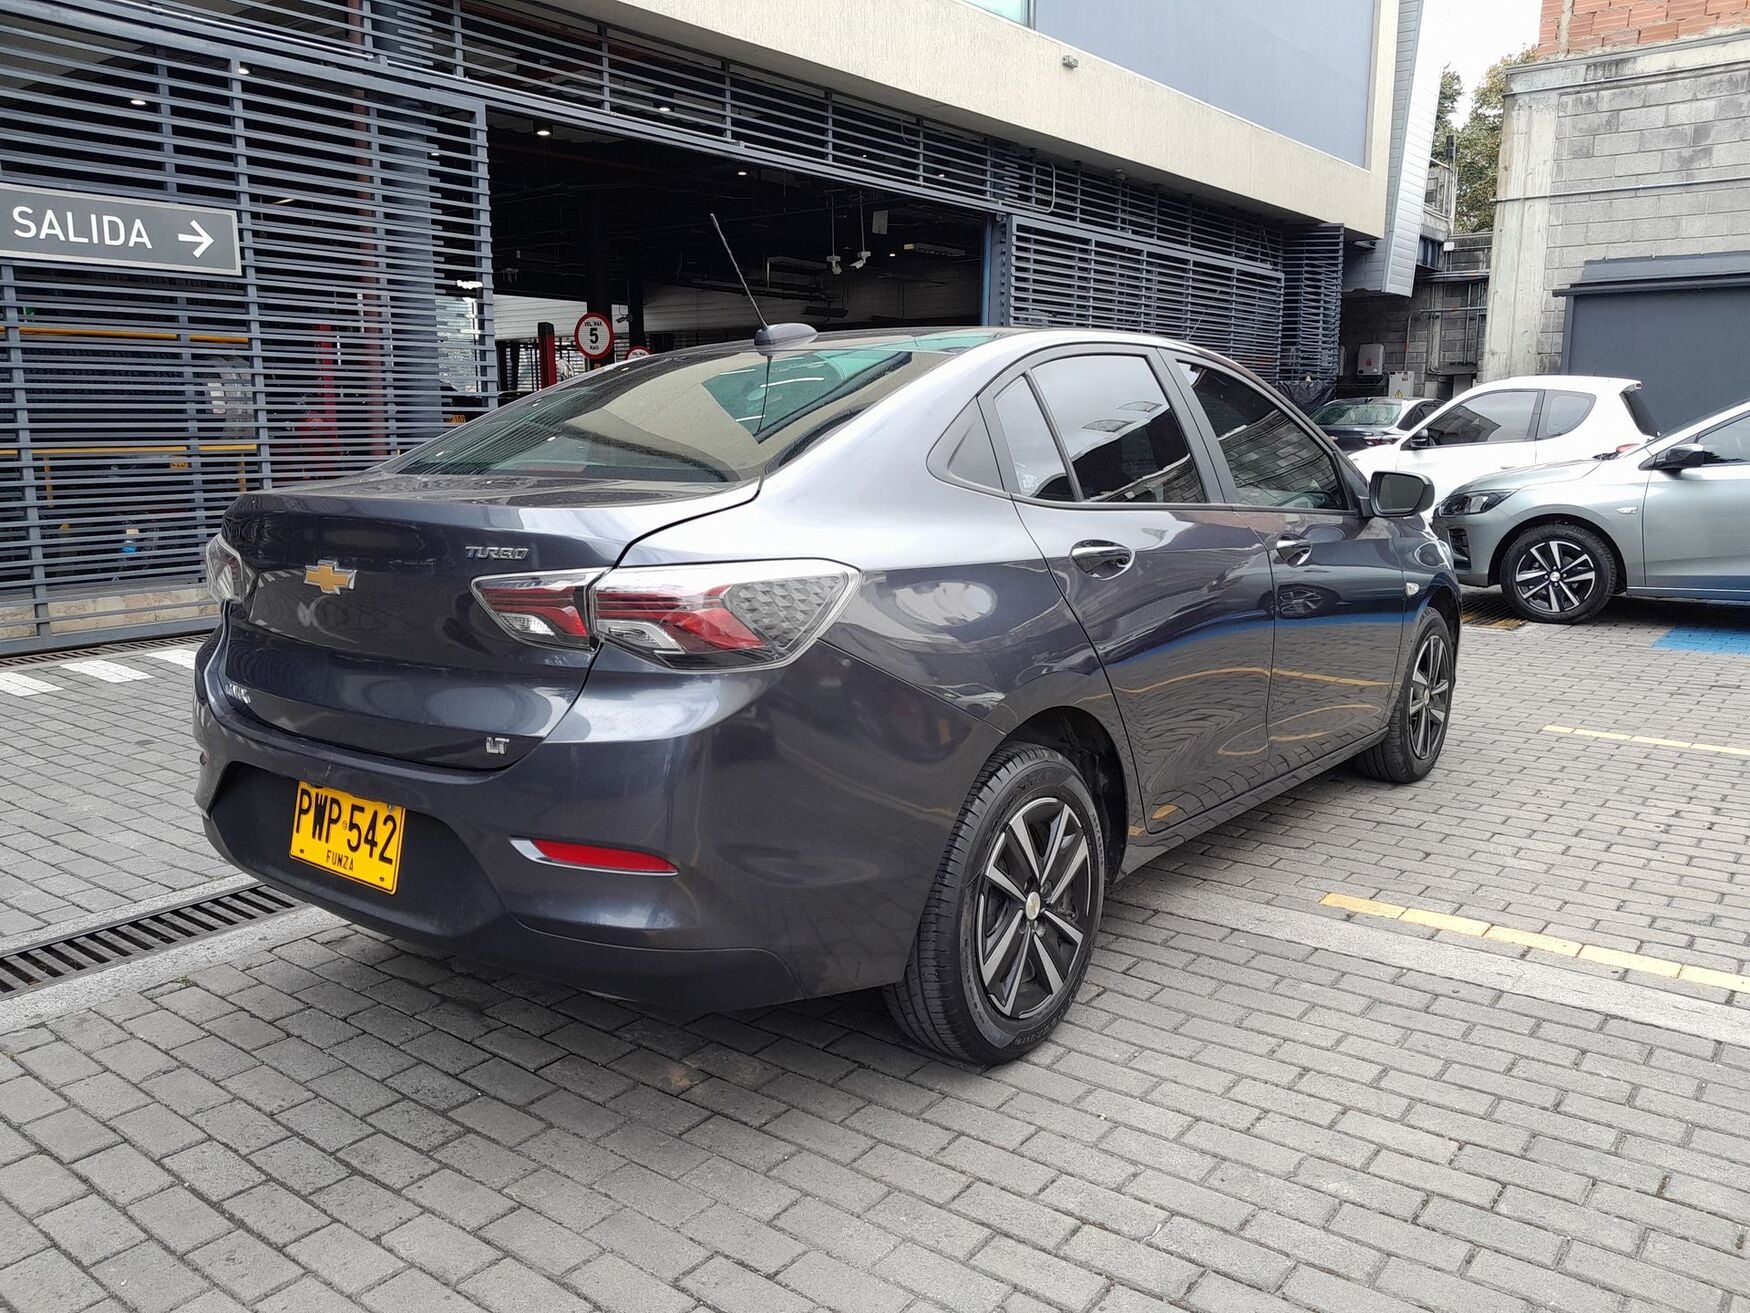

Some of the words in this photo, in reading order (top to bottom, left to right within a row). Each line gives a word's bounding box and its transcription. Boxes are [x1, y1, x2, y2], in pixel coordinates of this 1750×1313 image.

[12, 206, 153, 249] SALIDA
[589, 327, 599, 344] 5
[465, 546, 529, 560] TURBO
[486, 736, 510, 755] LT
[296, 788, 342, 844] PWP
[347, 803, 397, 865] 542
[326, 850, 354, 872] FUNZA
